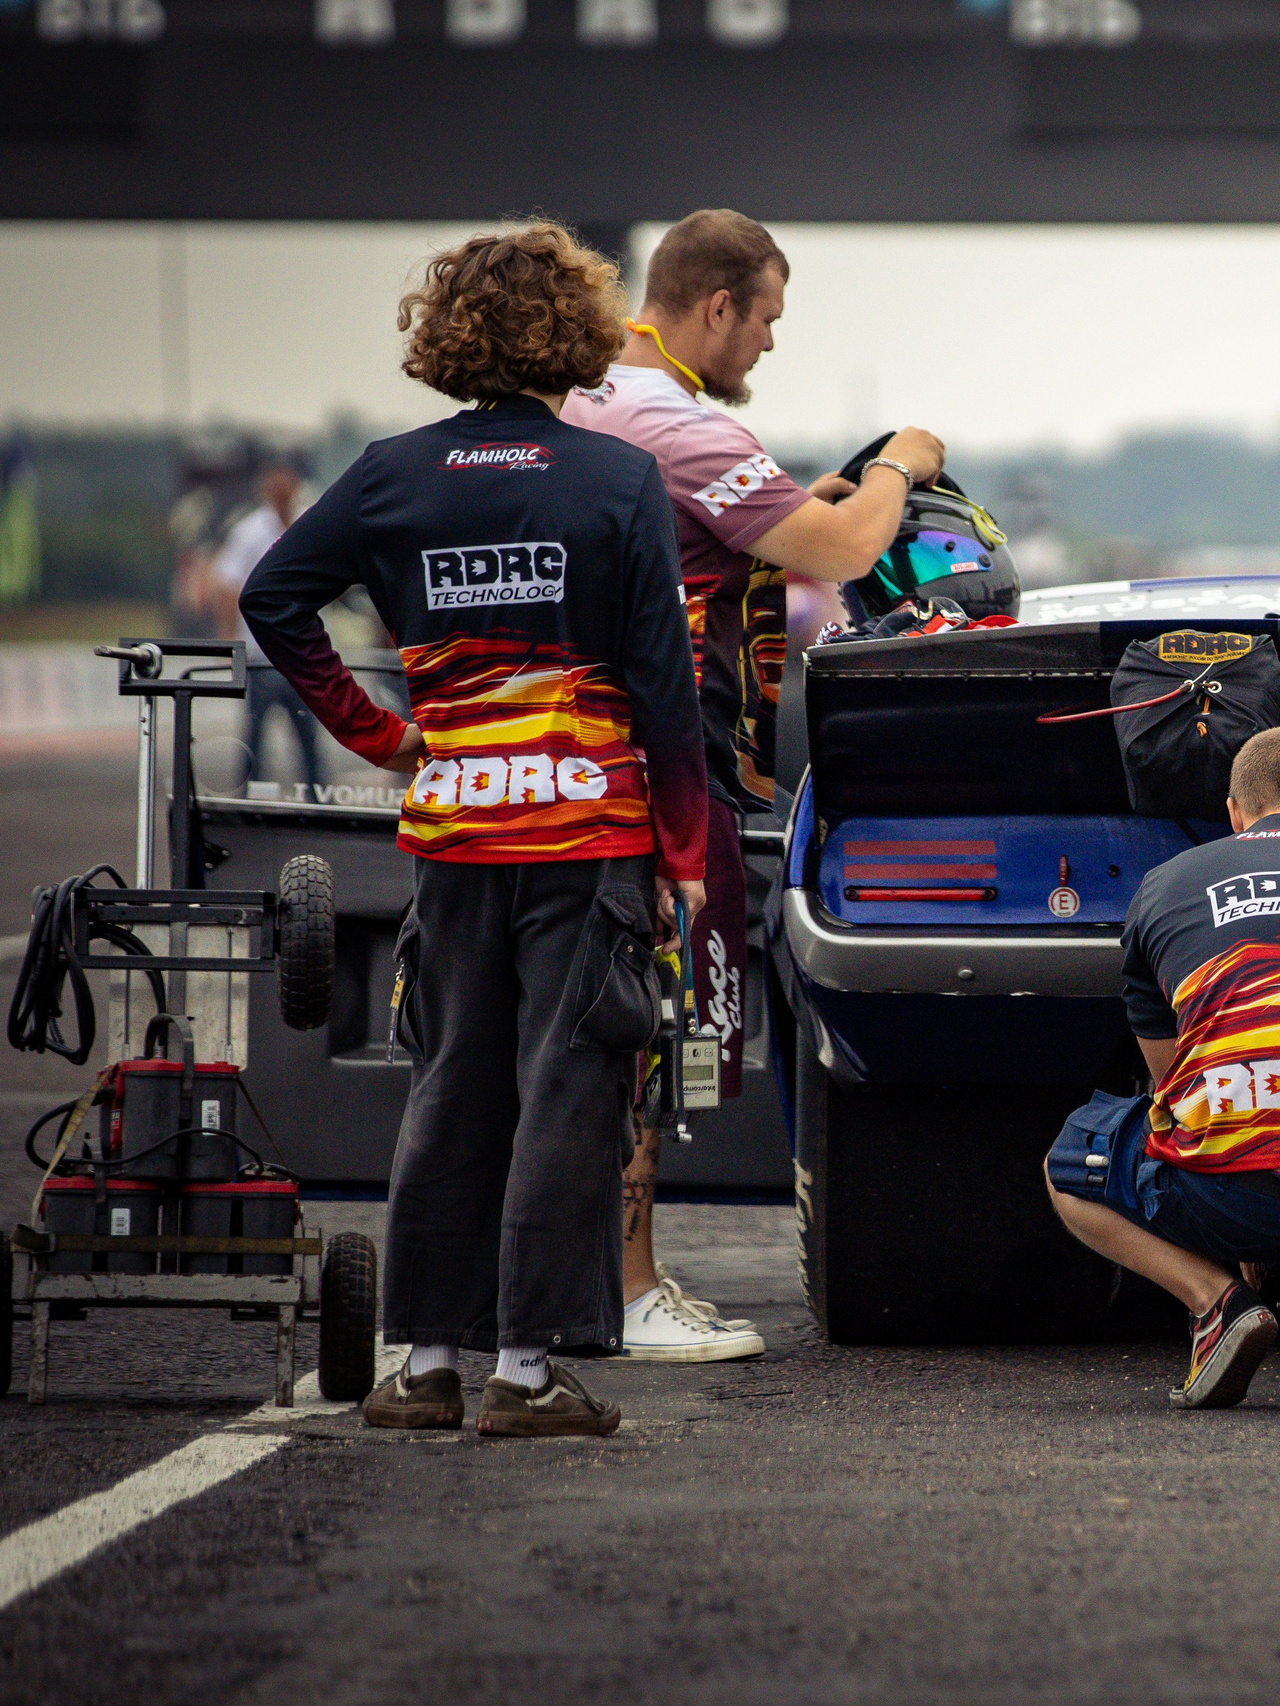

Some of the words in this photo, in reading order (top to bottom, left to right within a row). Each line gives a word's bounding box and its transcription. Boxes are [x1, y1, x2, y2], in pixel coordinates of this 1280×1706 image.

[446, 448, 540, 465] FLAMHOLC
[508, 461, 550, 472] Racing
[426, 545, 565, 589] RDRC
[431, 584, 563, 607] TECHNOLOGY
[1162, 634, 1250, 655] RDRC
[412, 753, 608, 806] RDRC
[1059, 893, 1069, 910] E
